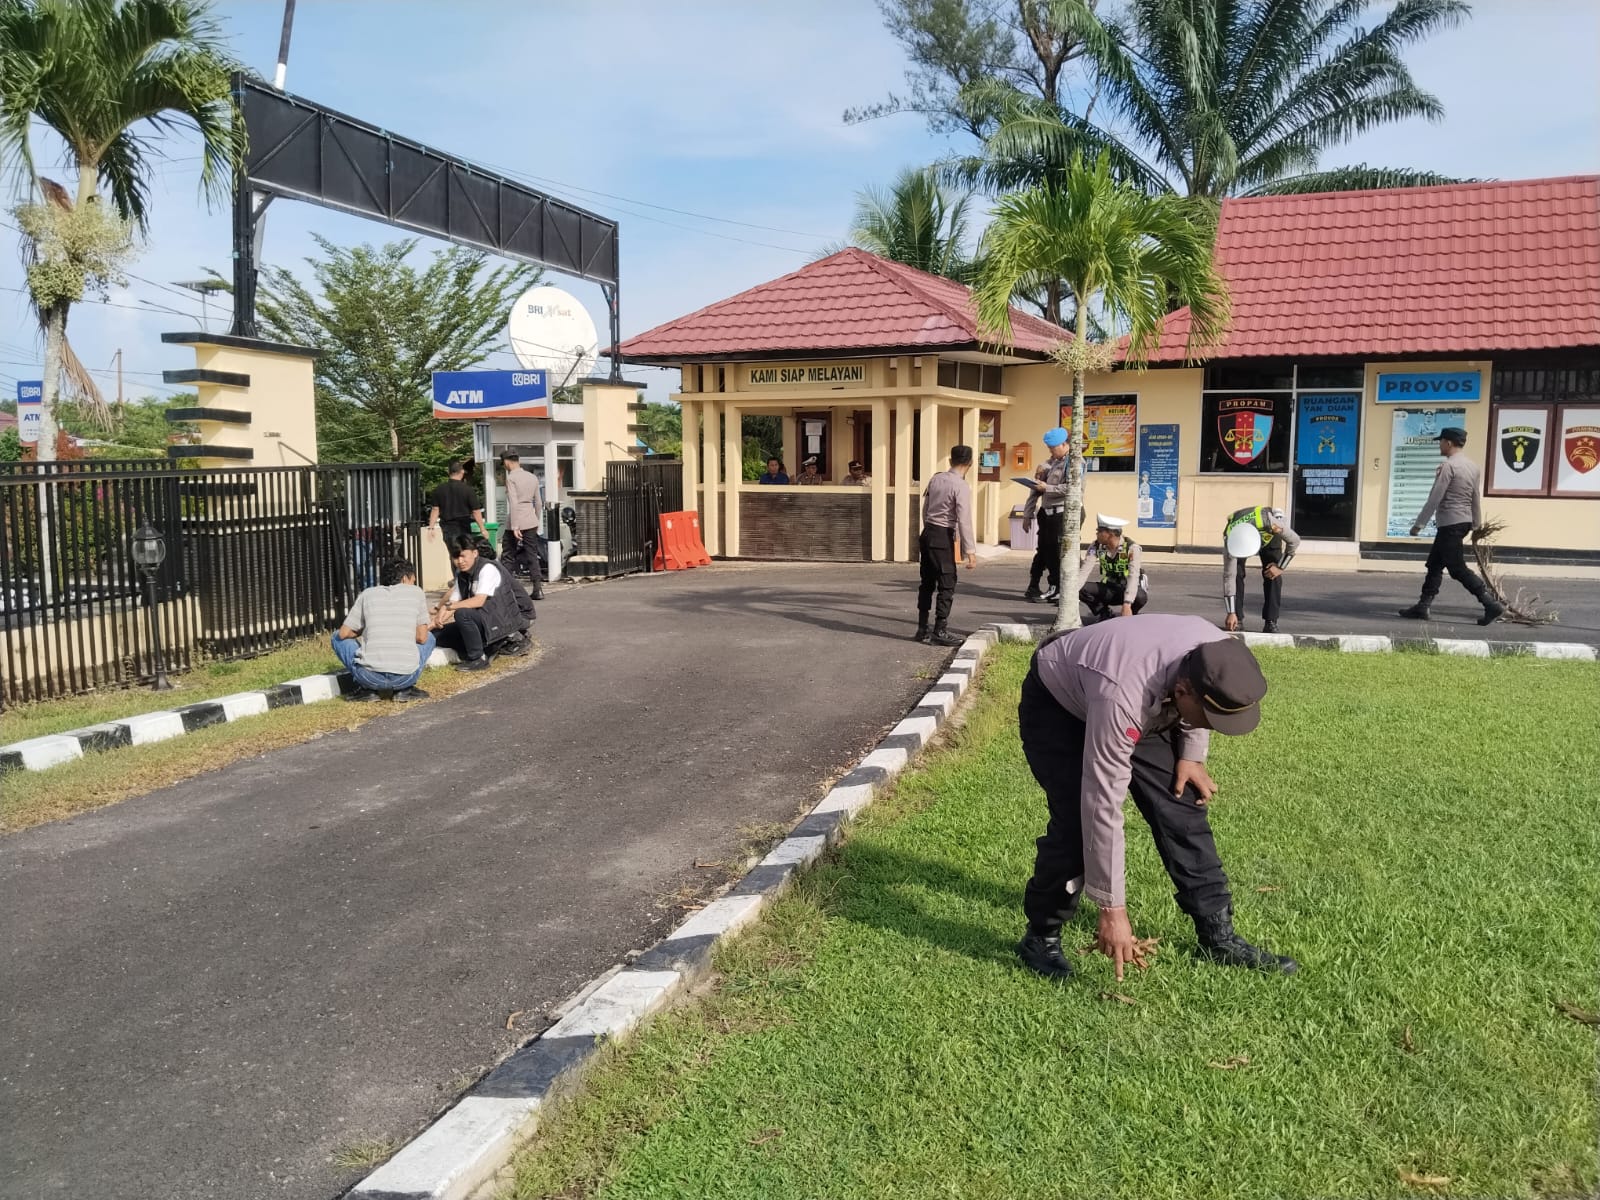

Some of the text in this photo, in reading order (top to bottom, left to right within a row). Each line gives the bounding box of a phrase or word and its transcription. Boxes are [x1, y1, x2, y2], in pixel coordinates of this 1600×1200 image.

[527, 304, 543, 315] BRI
[523, 373, 540, 385] BRI
[750, 366, 863, 383] KAMI SIAP MELAYANI
[28, 387, 40, 397] BRI
[1385, 380, 1473, 393] PROVOS
[446, 390, 484, 404] ATM
[1303, 397, 1354, 405] RUANGAN
